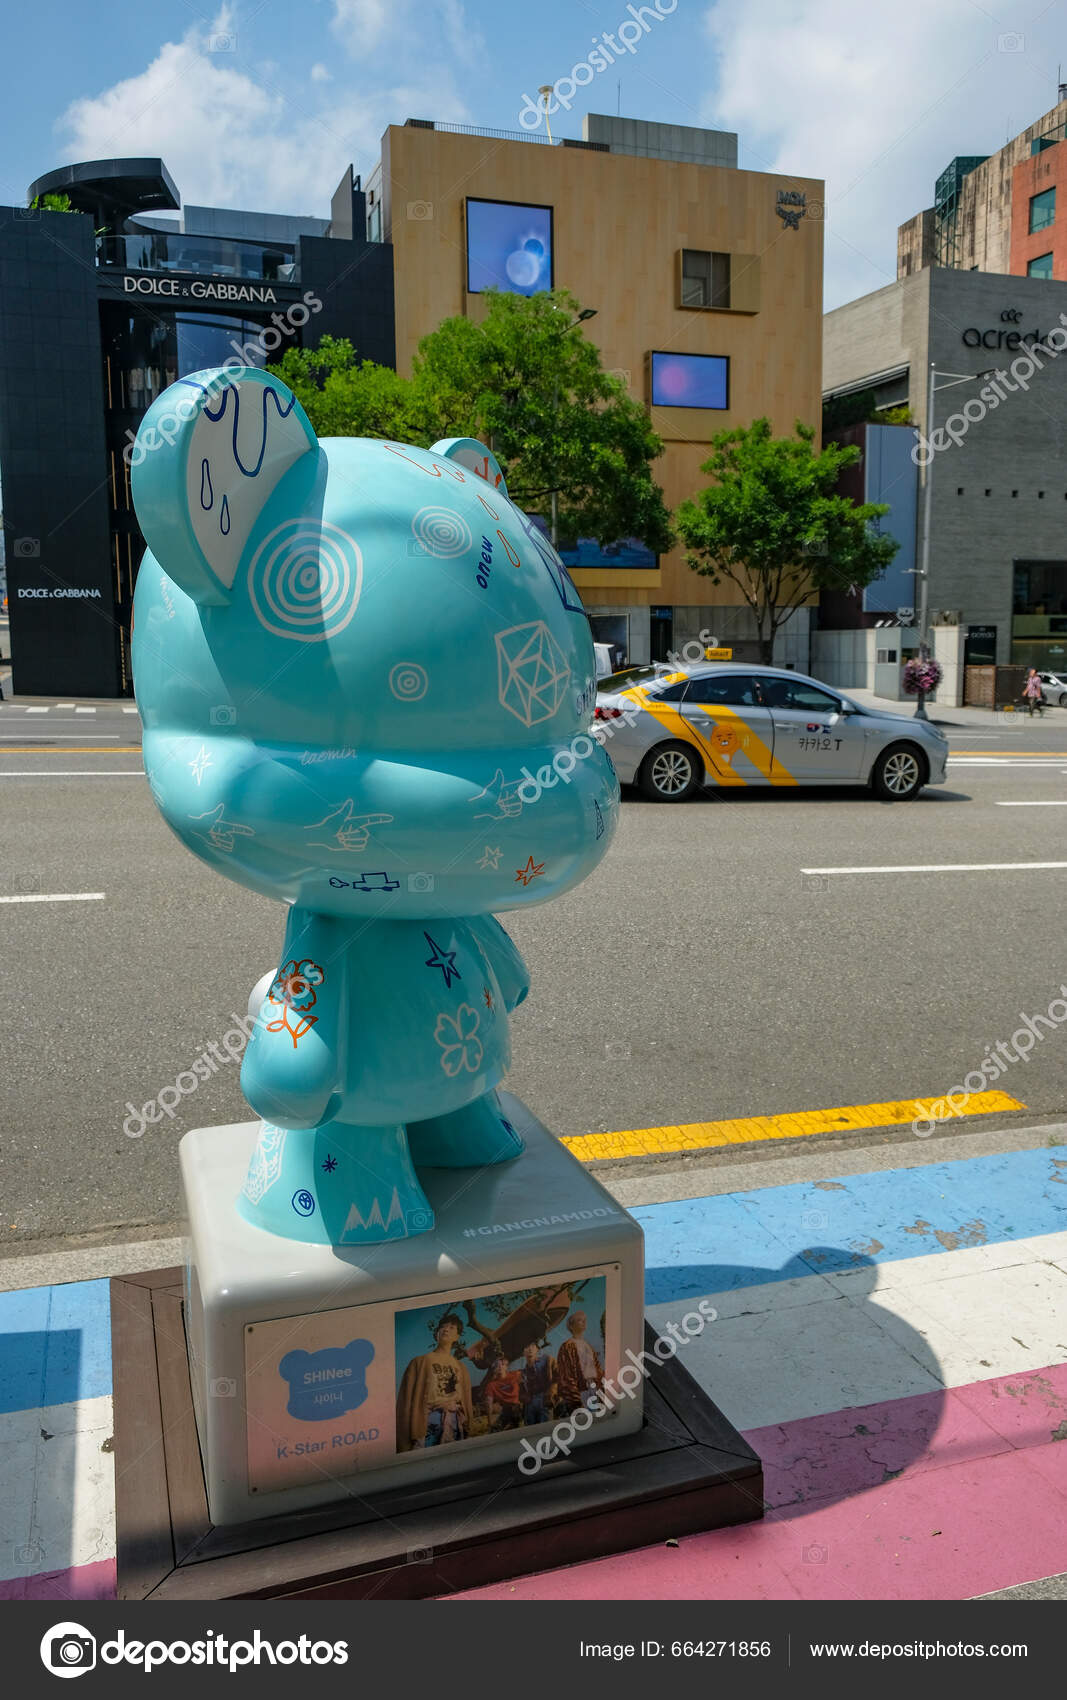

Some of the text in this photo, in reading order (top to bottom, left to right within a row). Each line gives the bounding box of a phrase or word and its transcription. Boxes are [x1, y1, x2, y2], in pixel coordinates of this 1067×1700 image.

[123, 276, 277, 304] DOLCE & GABBANA
[475, 535, 493, 590] onew
[17, 588, 49, 598] DOLCE
[53, 588, 102, 599] GABBANA
[799, 737, 844, 752] 카카오 T
[462, 1206, 621, 1238] #GANGNAMDOL
[303, 1367, 353, 1385] SHINee
[277, 1427, 380, 1460] K-Star ROAD
